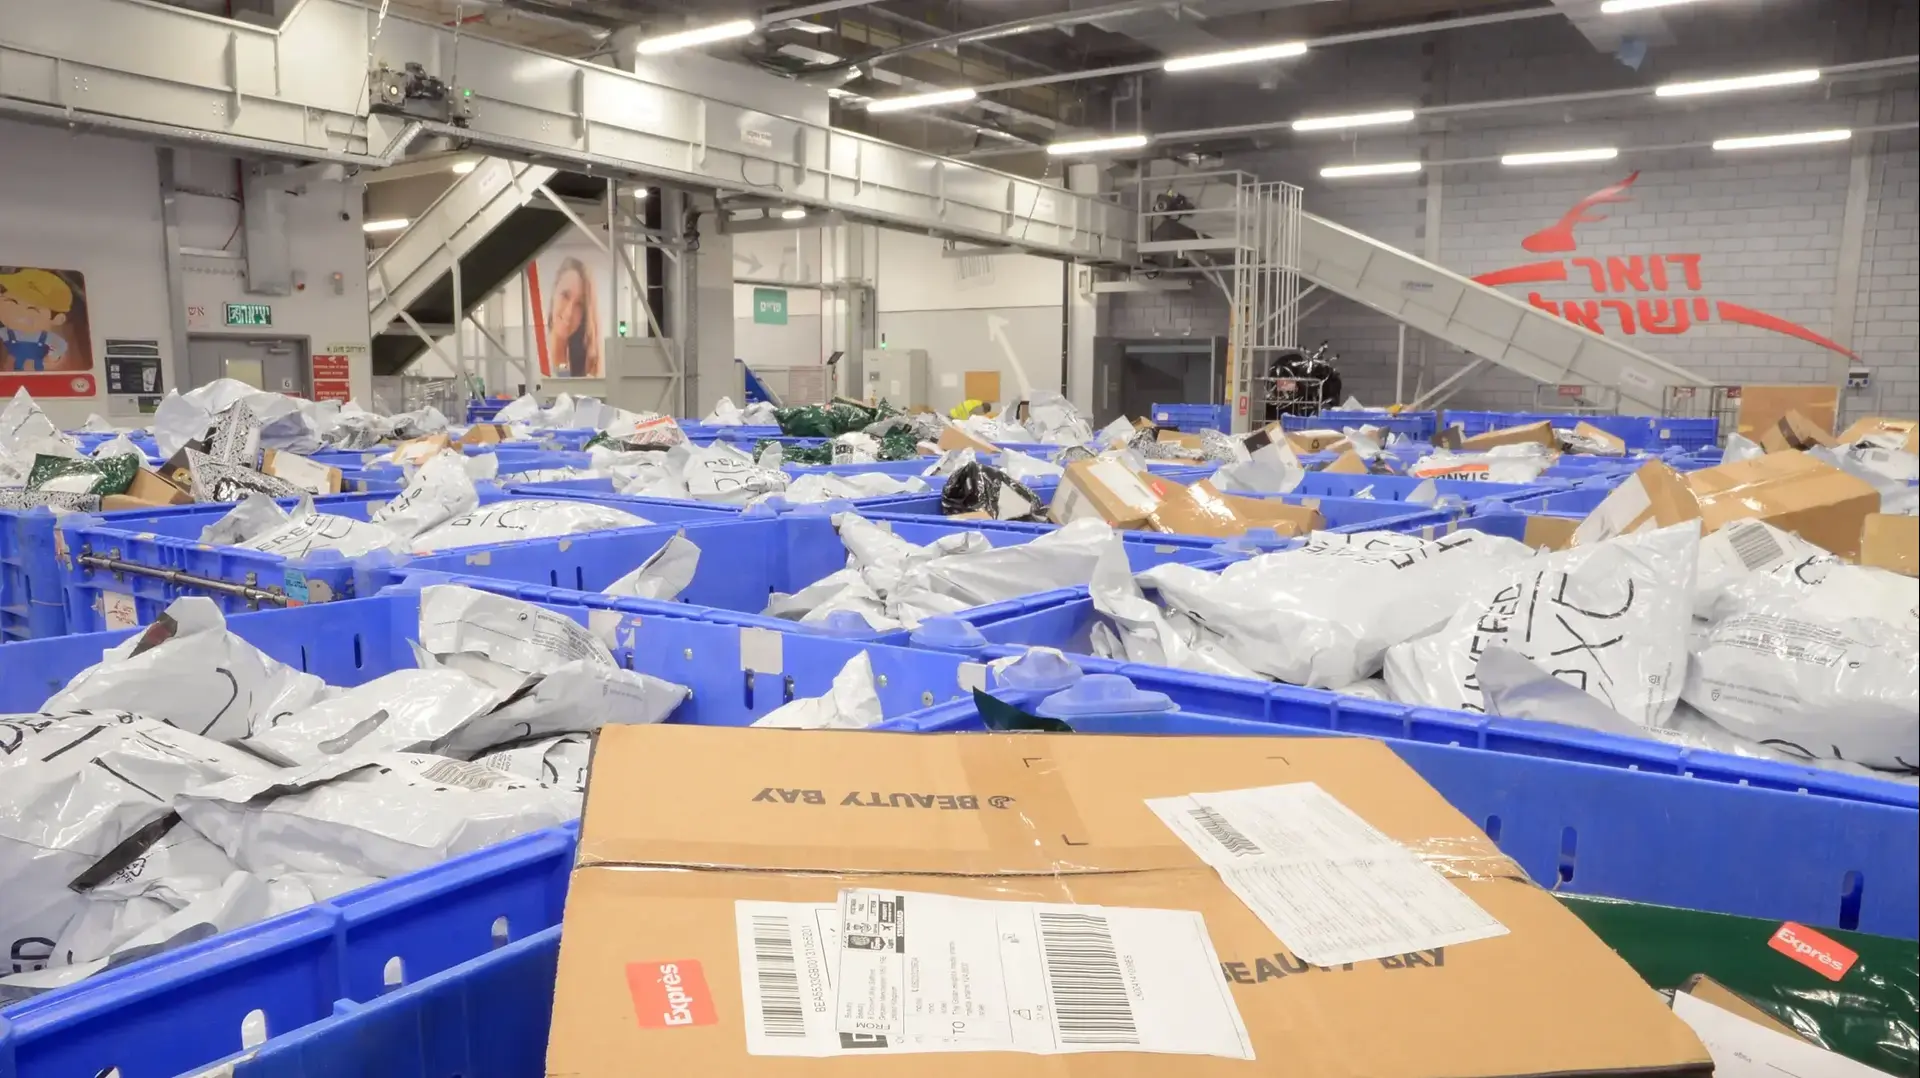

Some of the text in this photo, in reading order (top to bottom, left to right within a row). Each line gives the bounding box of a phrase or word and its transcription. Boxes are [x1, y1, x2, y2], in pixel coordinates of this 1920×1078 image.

[1571, 253, 1701, 292] דואר
[239, 305, 270, 324] יציאה
[1528, 292, 1709, 335] ישראל
[752, 787, 980, 810] BEAUTY BAY
[1776, 927, 1844, 971] Exprès
[656, 963, 693, 1026] Exprès
[855, 1021, 891, 1031] FROM
[951, 1020, 966, 1035] TO
